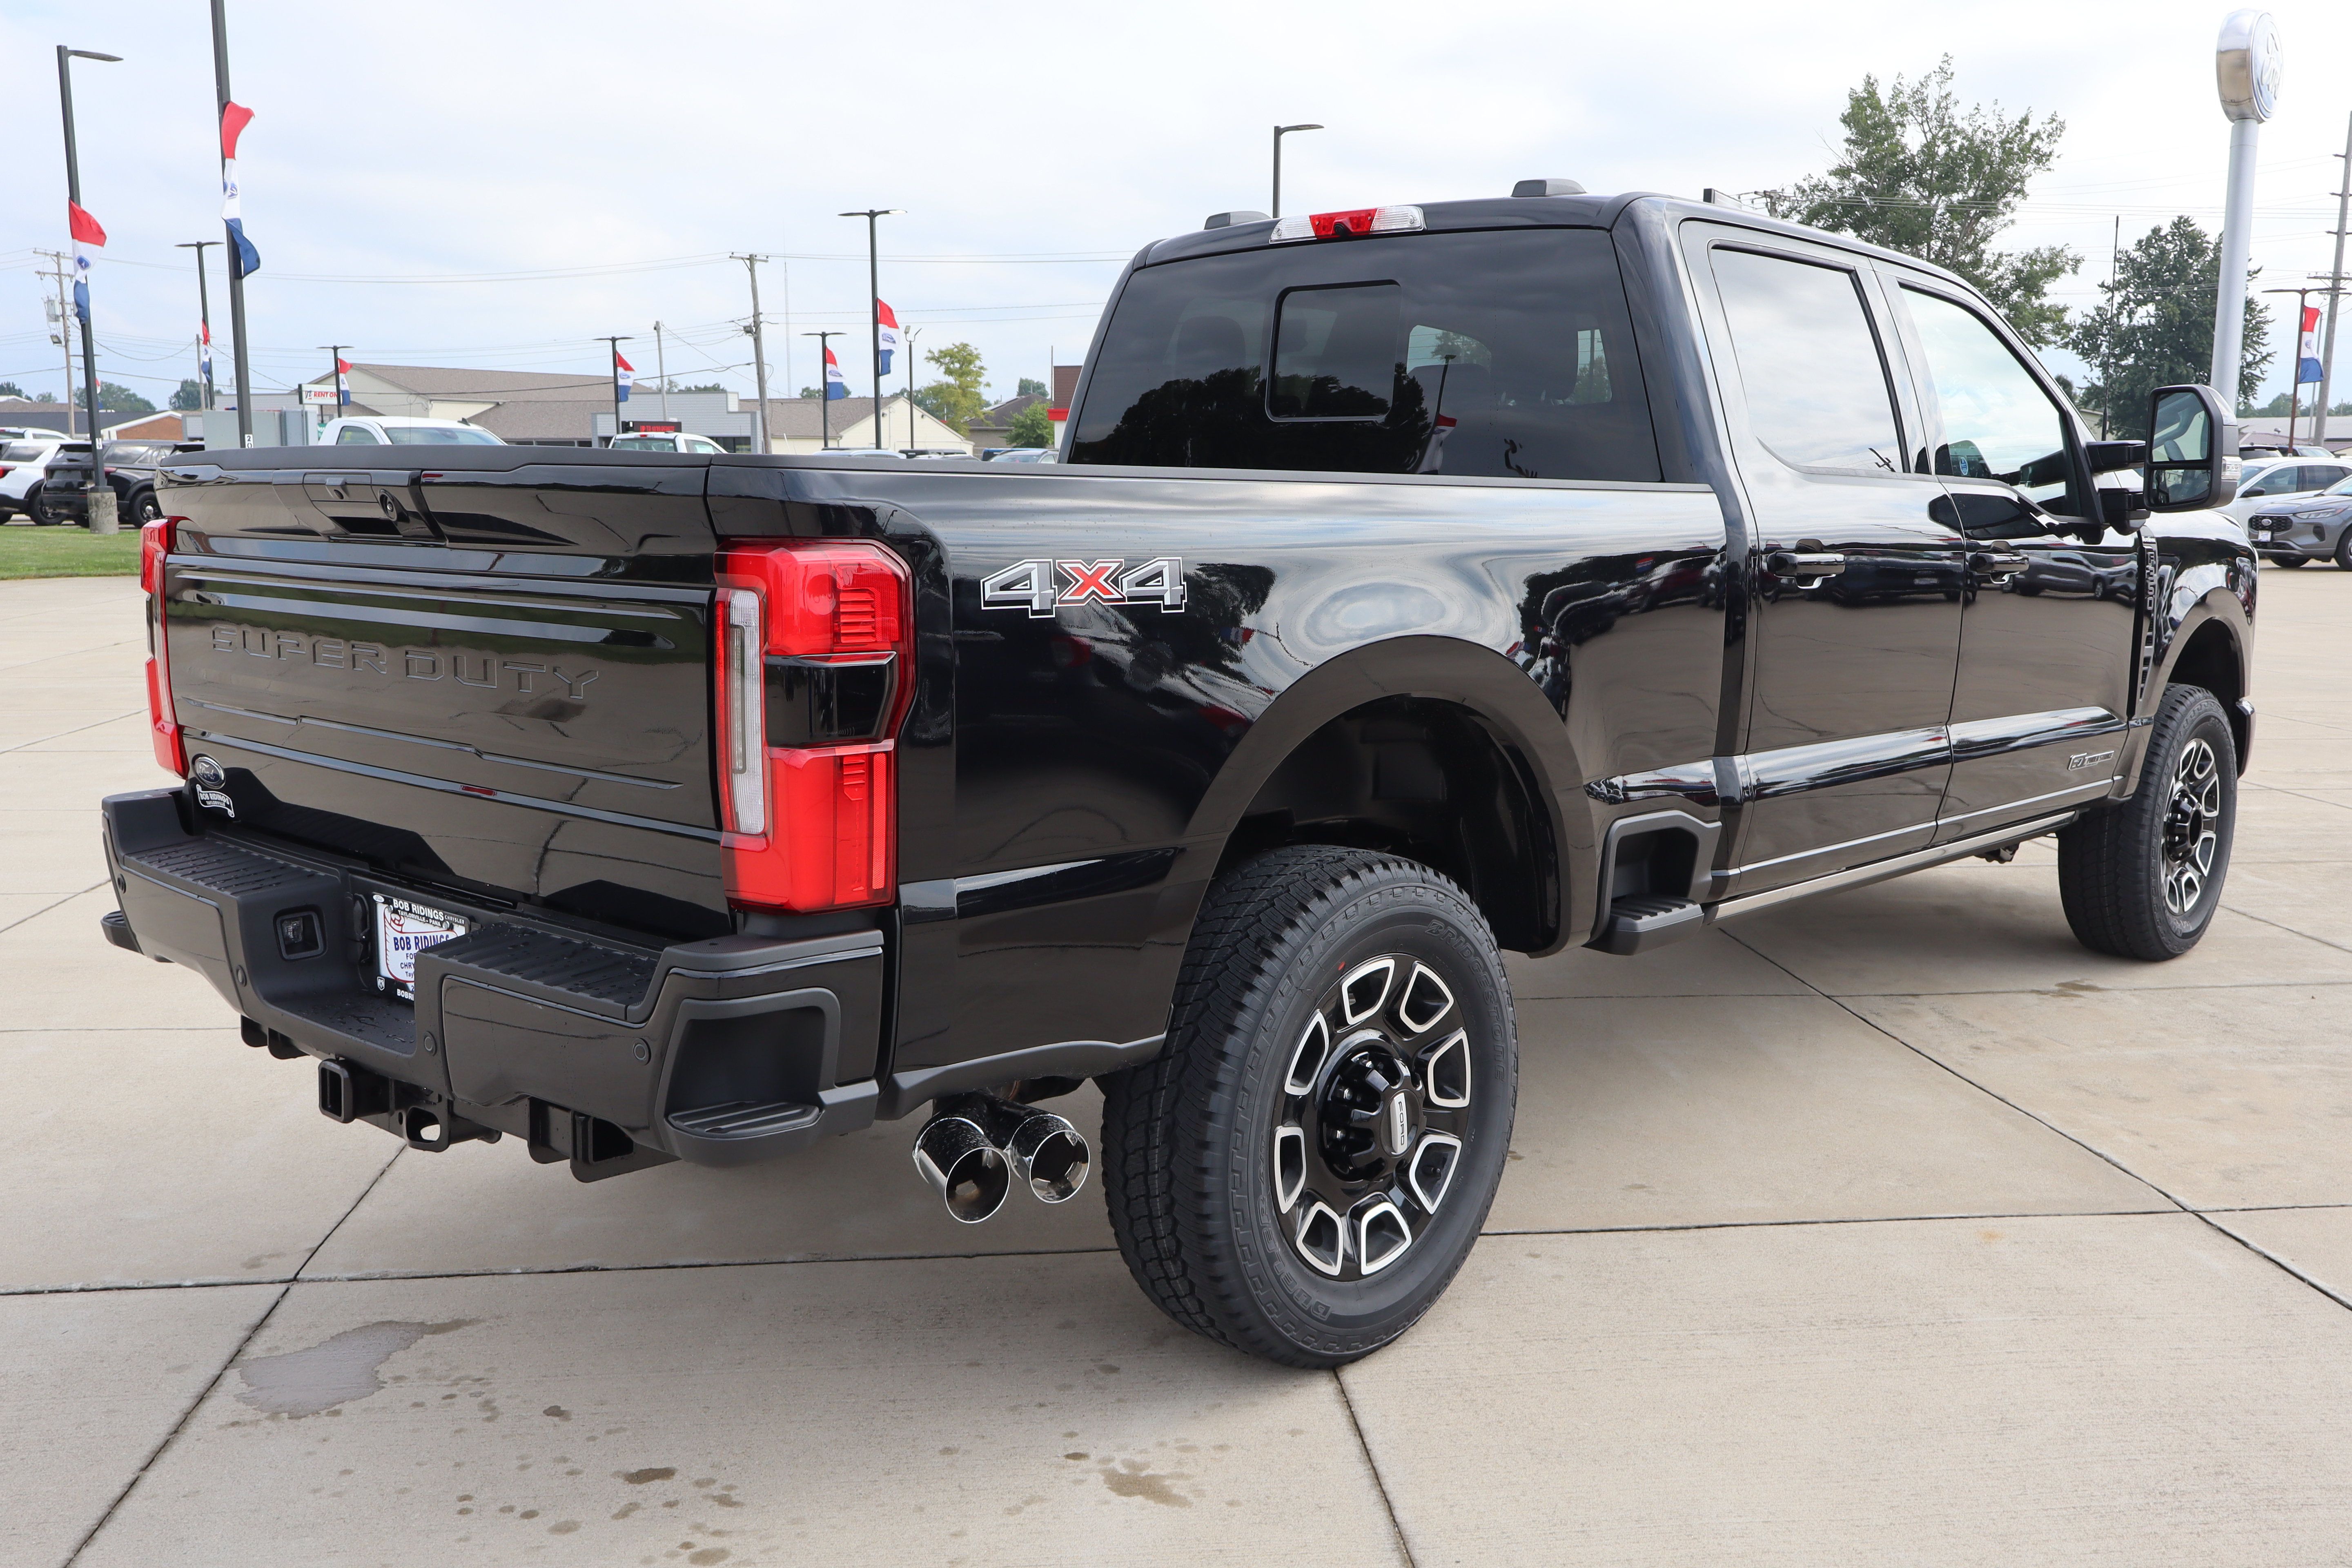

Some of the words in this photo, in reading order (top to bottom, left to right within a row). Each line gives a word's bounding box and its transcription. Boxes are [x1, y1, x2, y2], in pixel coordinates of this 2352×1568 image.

[212, 625, 387, 674] SUPER
[405, 650, 598, 699] DUTY
[199, 762, 215, 780] Ford
[209, 793, 229, 805] RIDINGS
[393, 899, 410, 911] BOB
[411, 904, 444, 921] RIDINGS
[398, 910, 426, 922] TAYLORVILLE
[445, 915, 465, 924] CHRYSLER
[393, 936, 412, 951] BOB
[397, 988, 414, 1001] BOBRI
[1424, 919, 1506, 1083] BRIDGESTONE
[1257, 1195, 1332, 1320] DUELER
